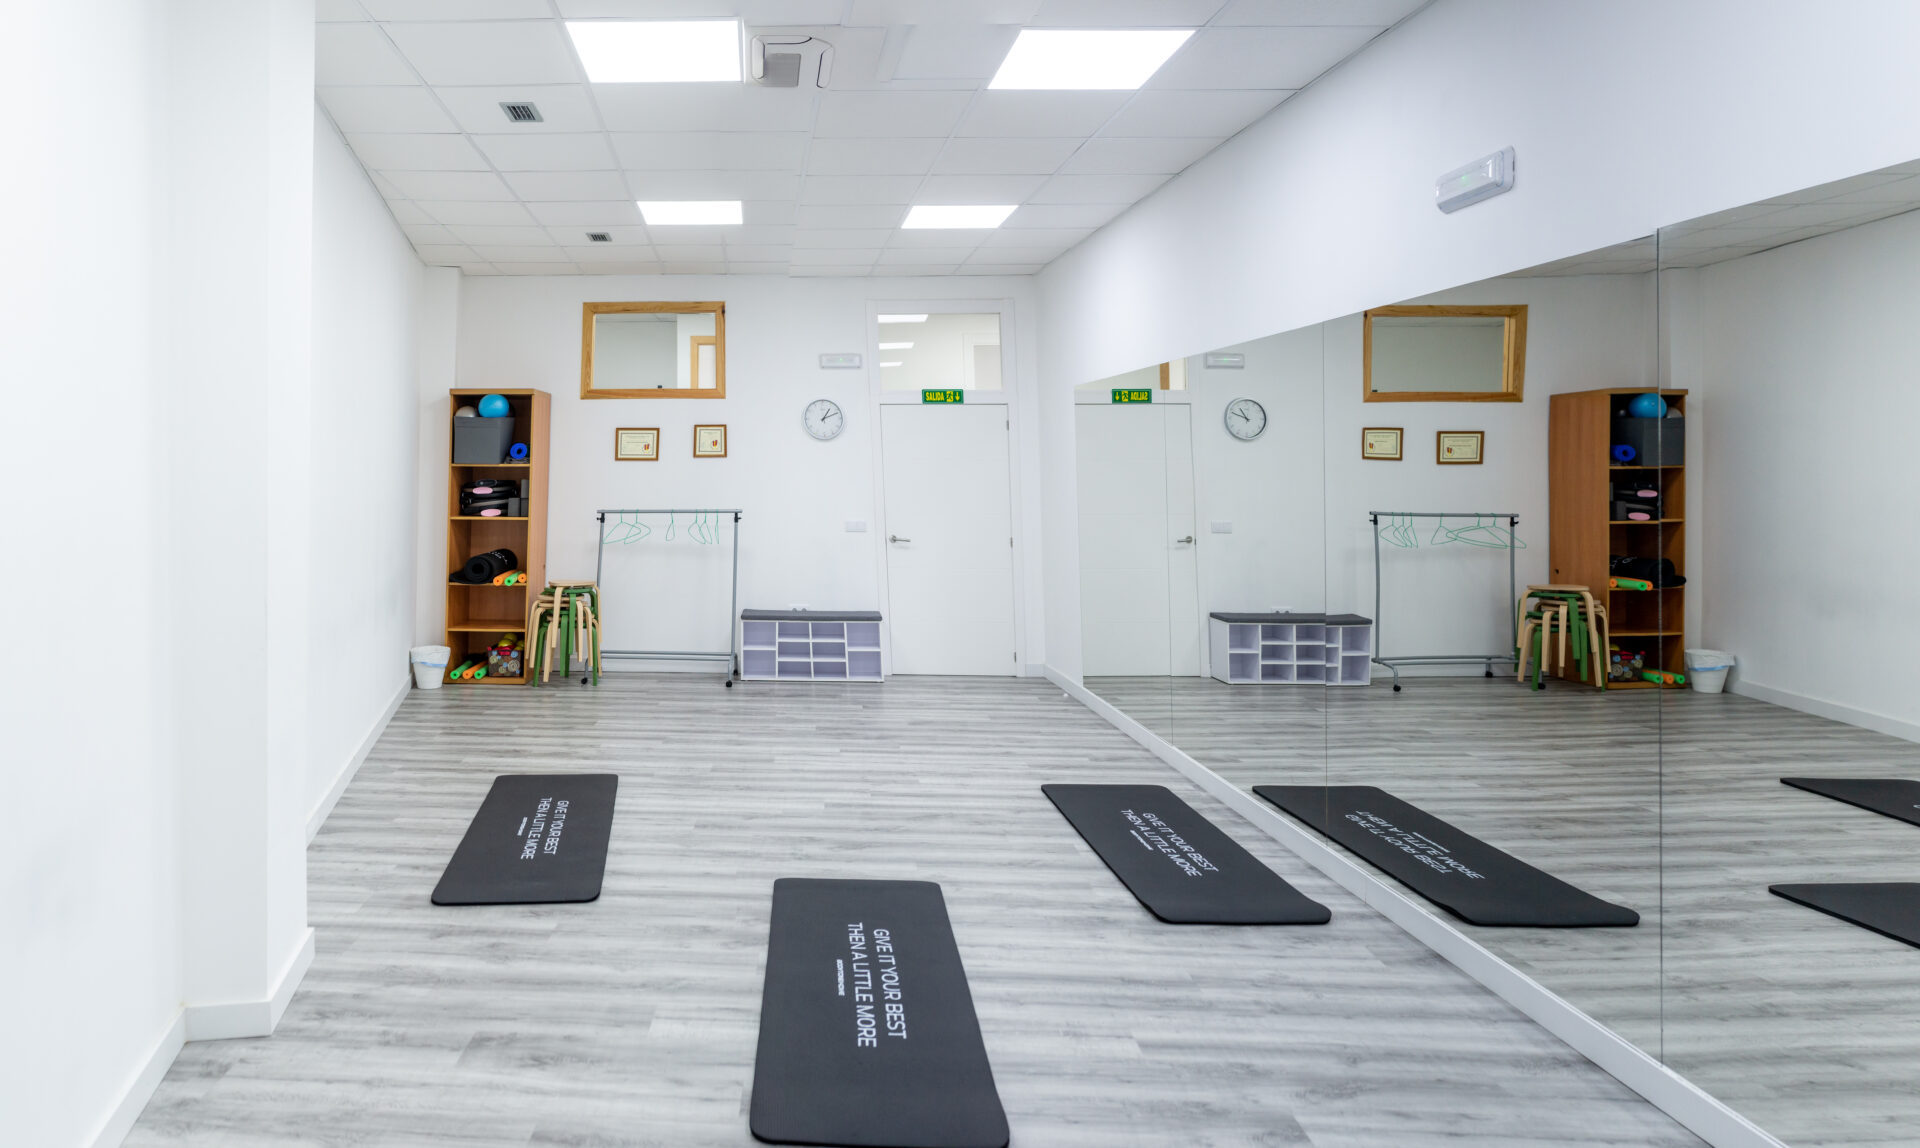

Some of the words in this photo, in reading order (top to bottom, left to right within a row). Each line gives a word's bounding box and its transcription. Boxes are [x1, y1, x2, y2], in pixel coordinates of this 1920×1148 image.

[925, 391, 944, 401] SALIDA
[537, 797, 552, 813] THEN
[555, 801, 569, 813] GIVE
[528, 818, 546, 838] LITTLE
[549, 820, 564, 836] YOUR
[520, 839, 539, 860] MORE
[544, 837, 559, 855] BEST
[1120, 809, 1143, 827] THEN
[1143, 831, 1177, 854] LITTLE
[1168, 853, 1203, 877] MORE
[1142, 812, 1167, 827] GIVE
[1166, 833, 1195, 853] YOUR
[1187, 852, 1219, 872] BEST
[848, 922, 866, 950] THEN
[873, 928, 893, 953] GIVE
[851, 951, 867, 961] A
[877, 954, 895, 965] IT
[853, 963, 873, 1002] LITTLE
[880, 966, 902, 1001] YOUR
[856, 1005, 877, 1048] MORE
[884, 1003, 907, 1039] BEST
